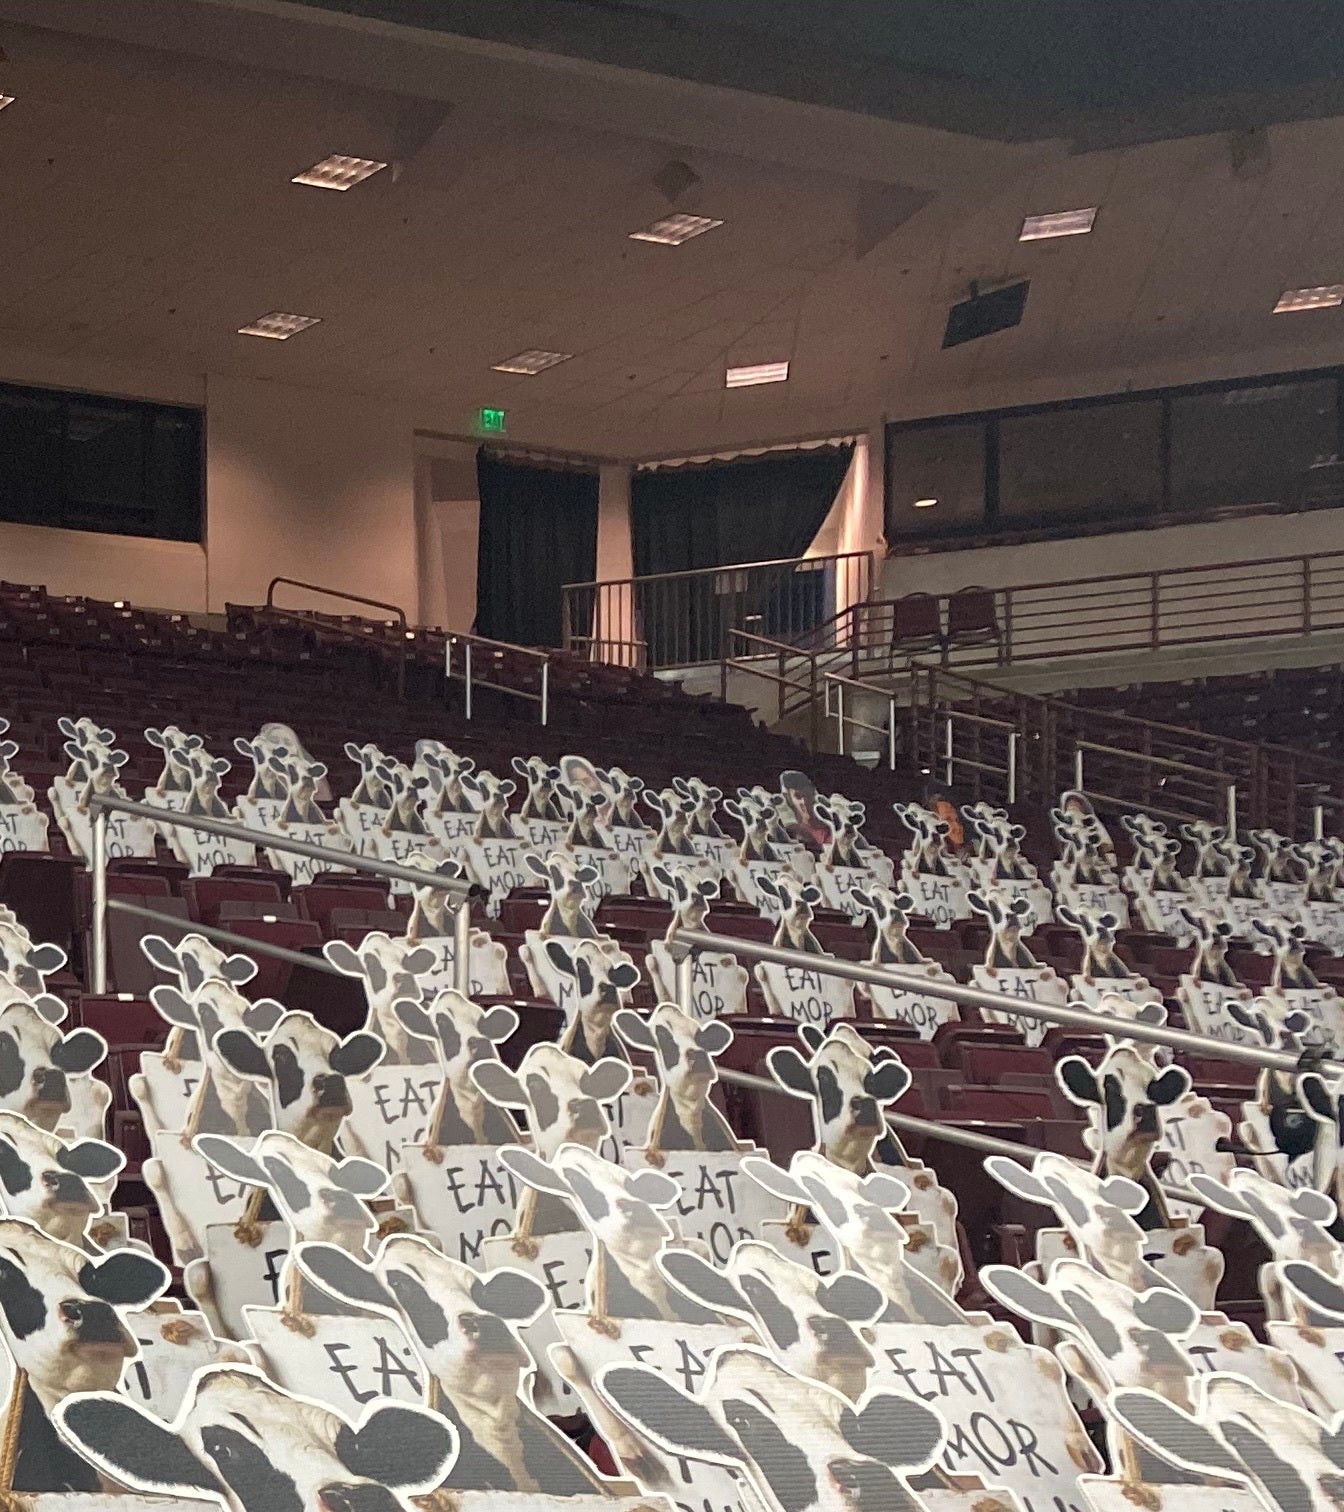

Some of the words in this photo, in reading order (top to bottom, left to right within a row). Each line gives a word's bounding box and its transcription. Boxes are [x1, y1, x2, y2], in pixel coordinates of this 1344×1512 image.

[103, 819, 126, 840] AT
[360, 812, 386, 831] EA
[444, 819, 475, 839] EAT
[530, 826, 558, 846] EAT
[614, 834, 643, 851] EAT
[109, 842, 134, 858] OR
[484, 845, 518, 868] EAT
[488, 871, 525, 893] MOR
[921, 881, 949, 901] EAT
[692, 962, 716, 987] AT
[791, 996, 833, 1022] MOR
[895, 1002, 939, 1027] MOR
[323, 1336, 425, 1405] EA
[885, 1341, 995, 1402] EAT
[944, 1412, 1059, 1477] MOR
